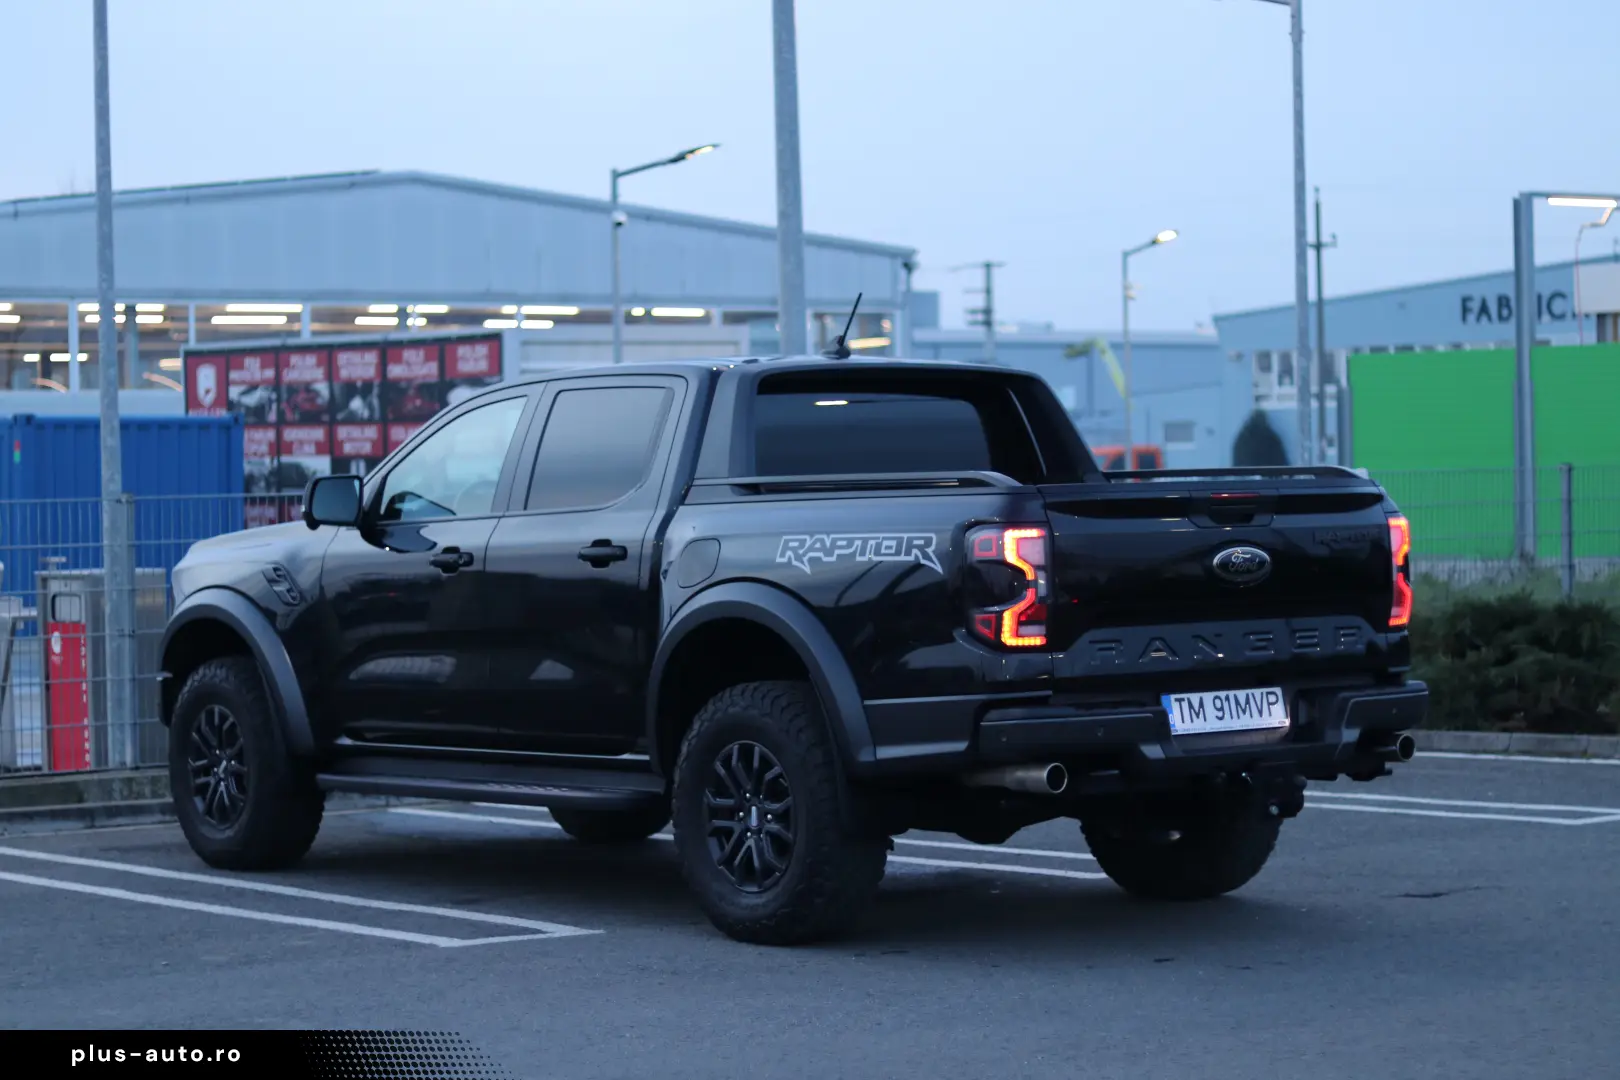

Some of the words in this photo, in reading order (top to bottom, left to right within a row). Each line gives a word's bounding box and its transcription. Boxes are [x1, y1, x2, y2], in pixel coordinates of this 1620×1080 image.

[1461, 291, 1590, 324] FABIC
[776, 533, 943, 575] RAPTOR
[1229, 552, 1259, 572] Ford
[1089, 626, 1364, 664] RANGER
[1174, 696, 1207, 724] TM
[1212, 691, 1280, 721] 91MVP
